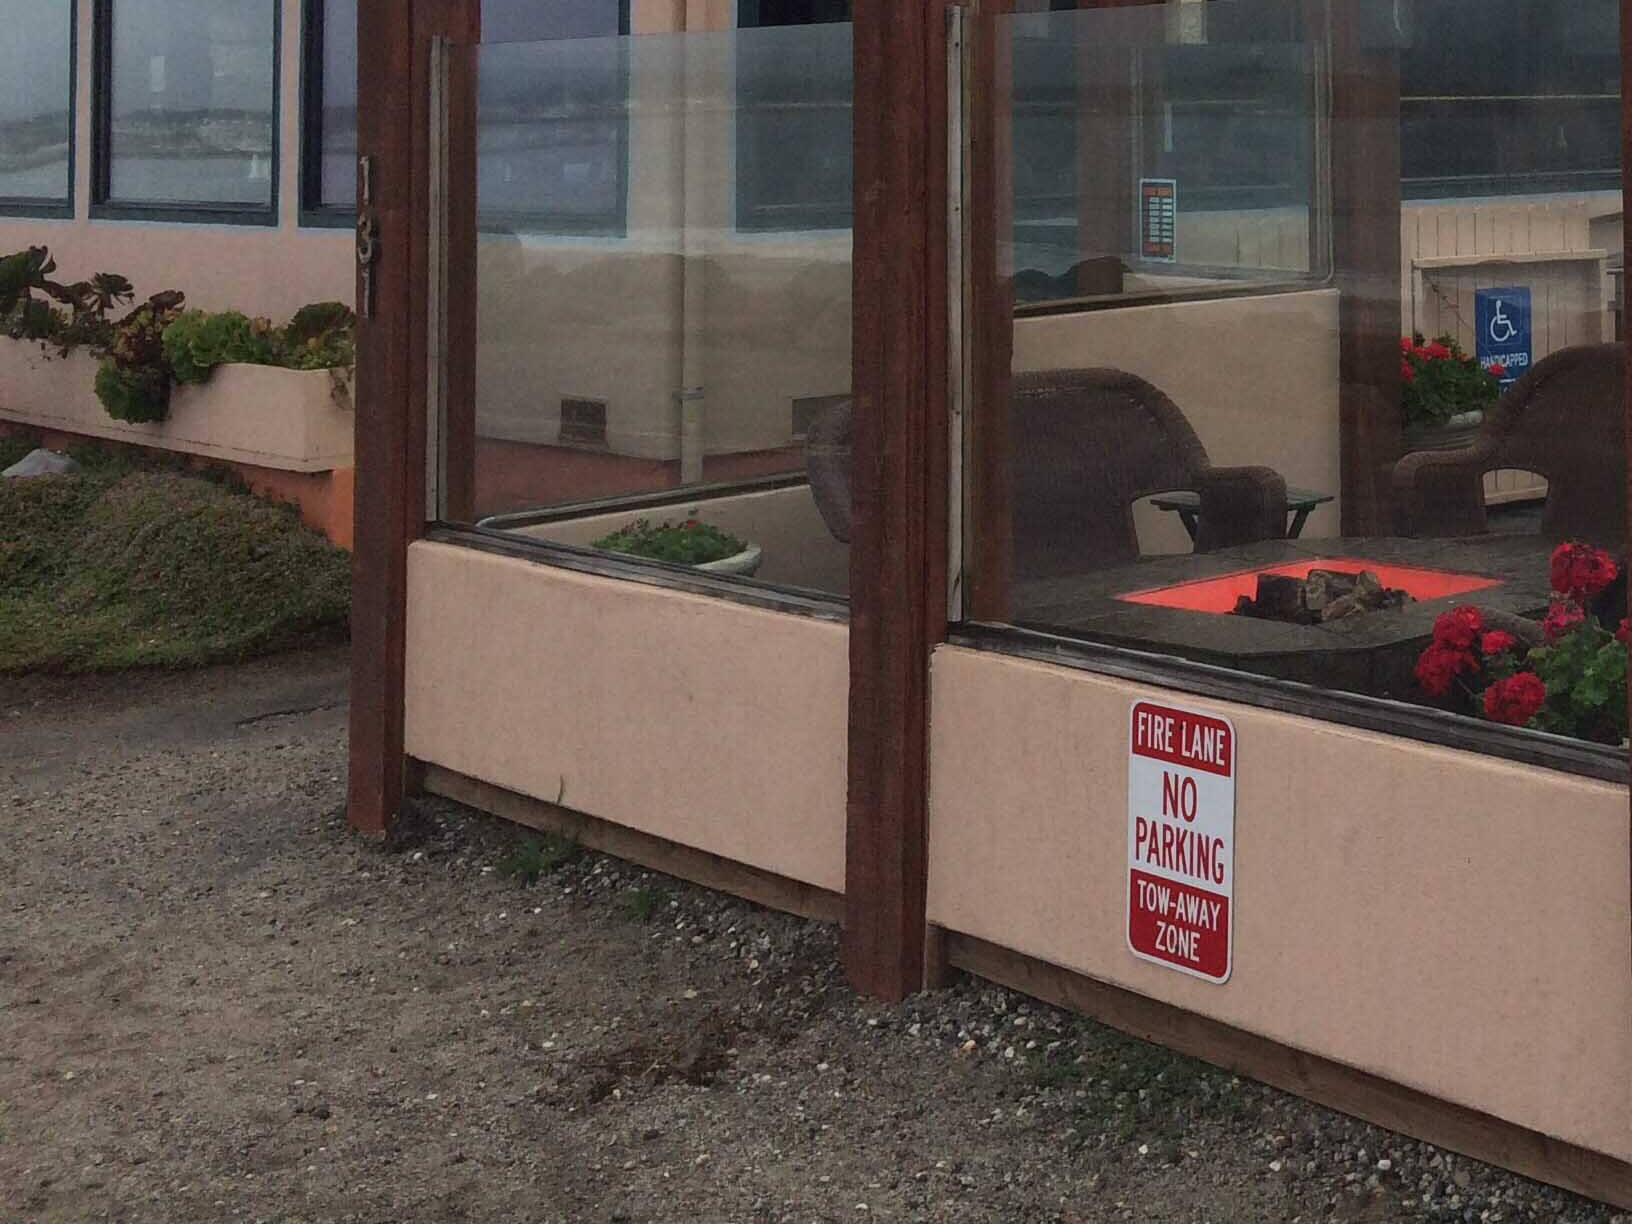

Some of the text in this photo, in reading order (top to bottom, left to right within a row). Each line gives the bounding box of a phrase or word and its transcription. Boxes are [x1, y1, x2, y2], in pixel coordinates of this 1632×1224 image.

[1137, 711, 1226, 766] FIRE LANE
[1162, 770, 1198, 823] NO
[1136, 816, 1225, 885] PARKING
[1137, 879, 1222, 932] TOW-AWAY
[1155, 920, 1201, 963] ZONE
